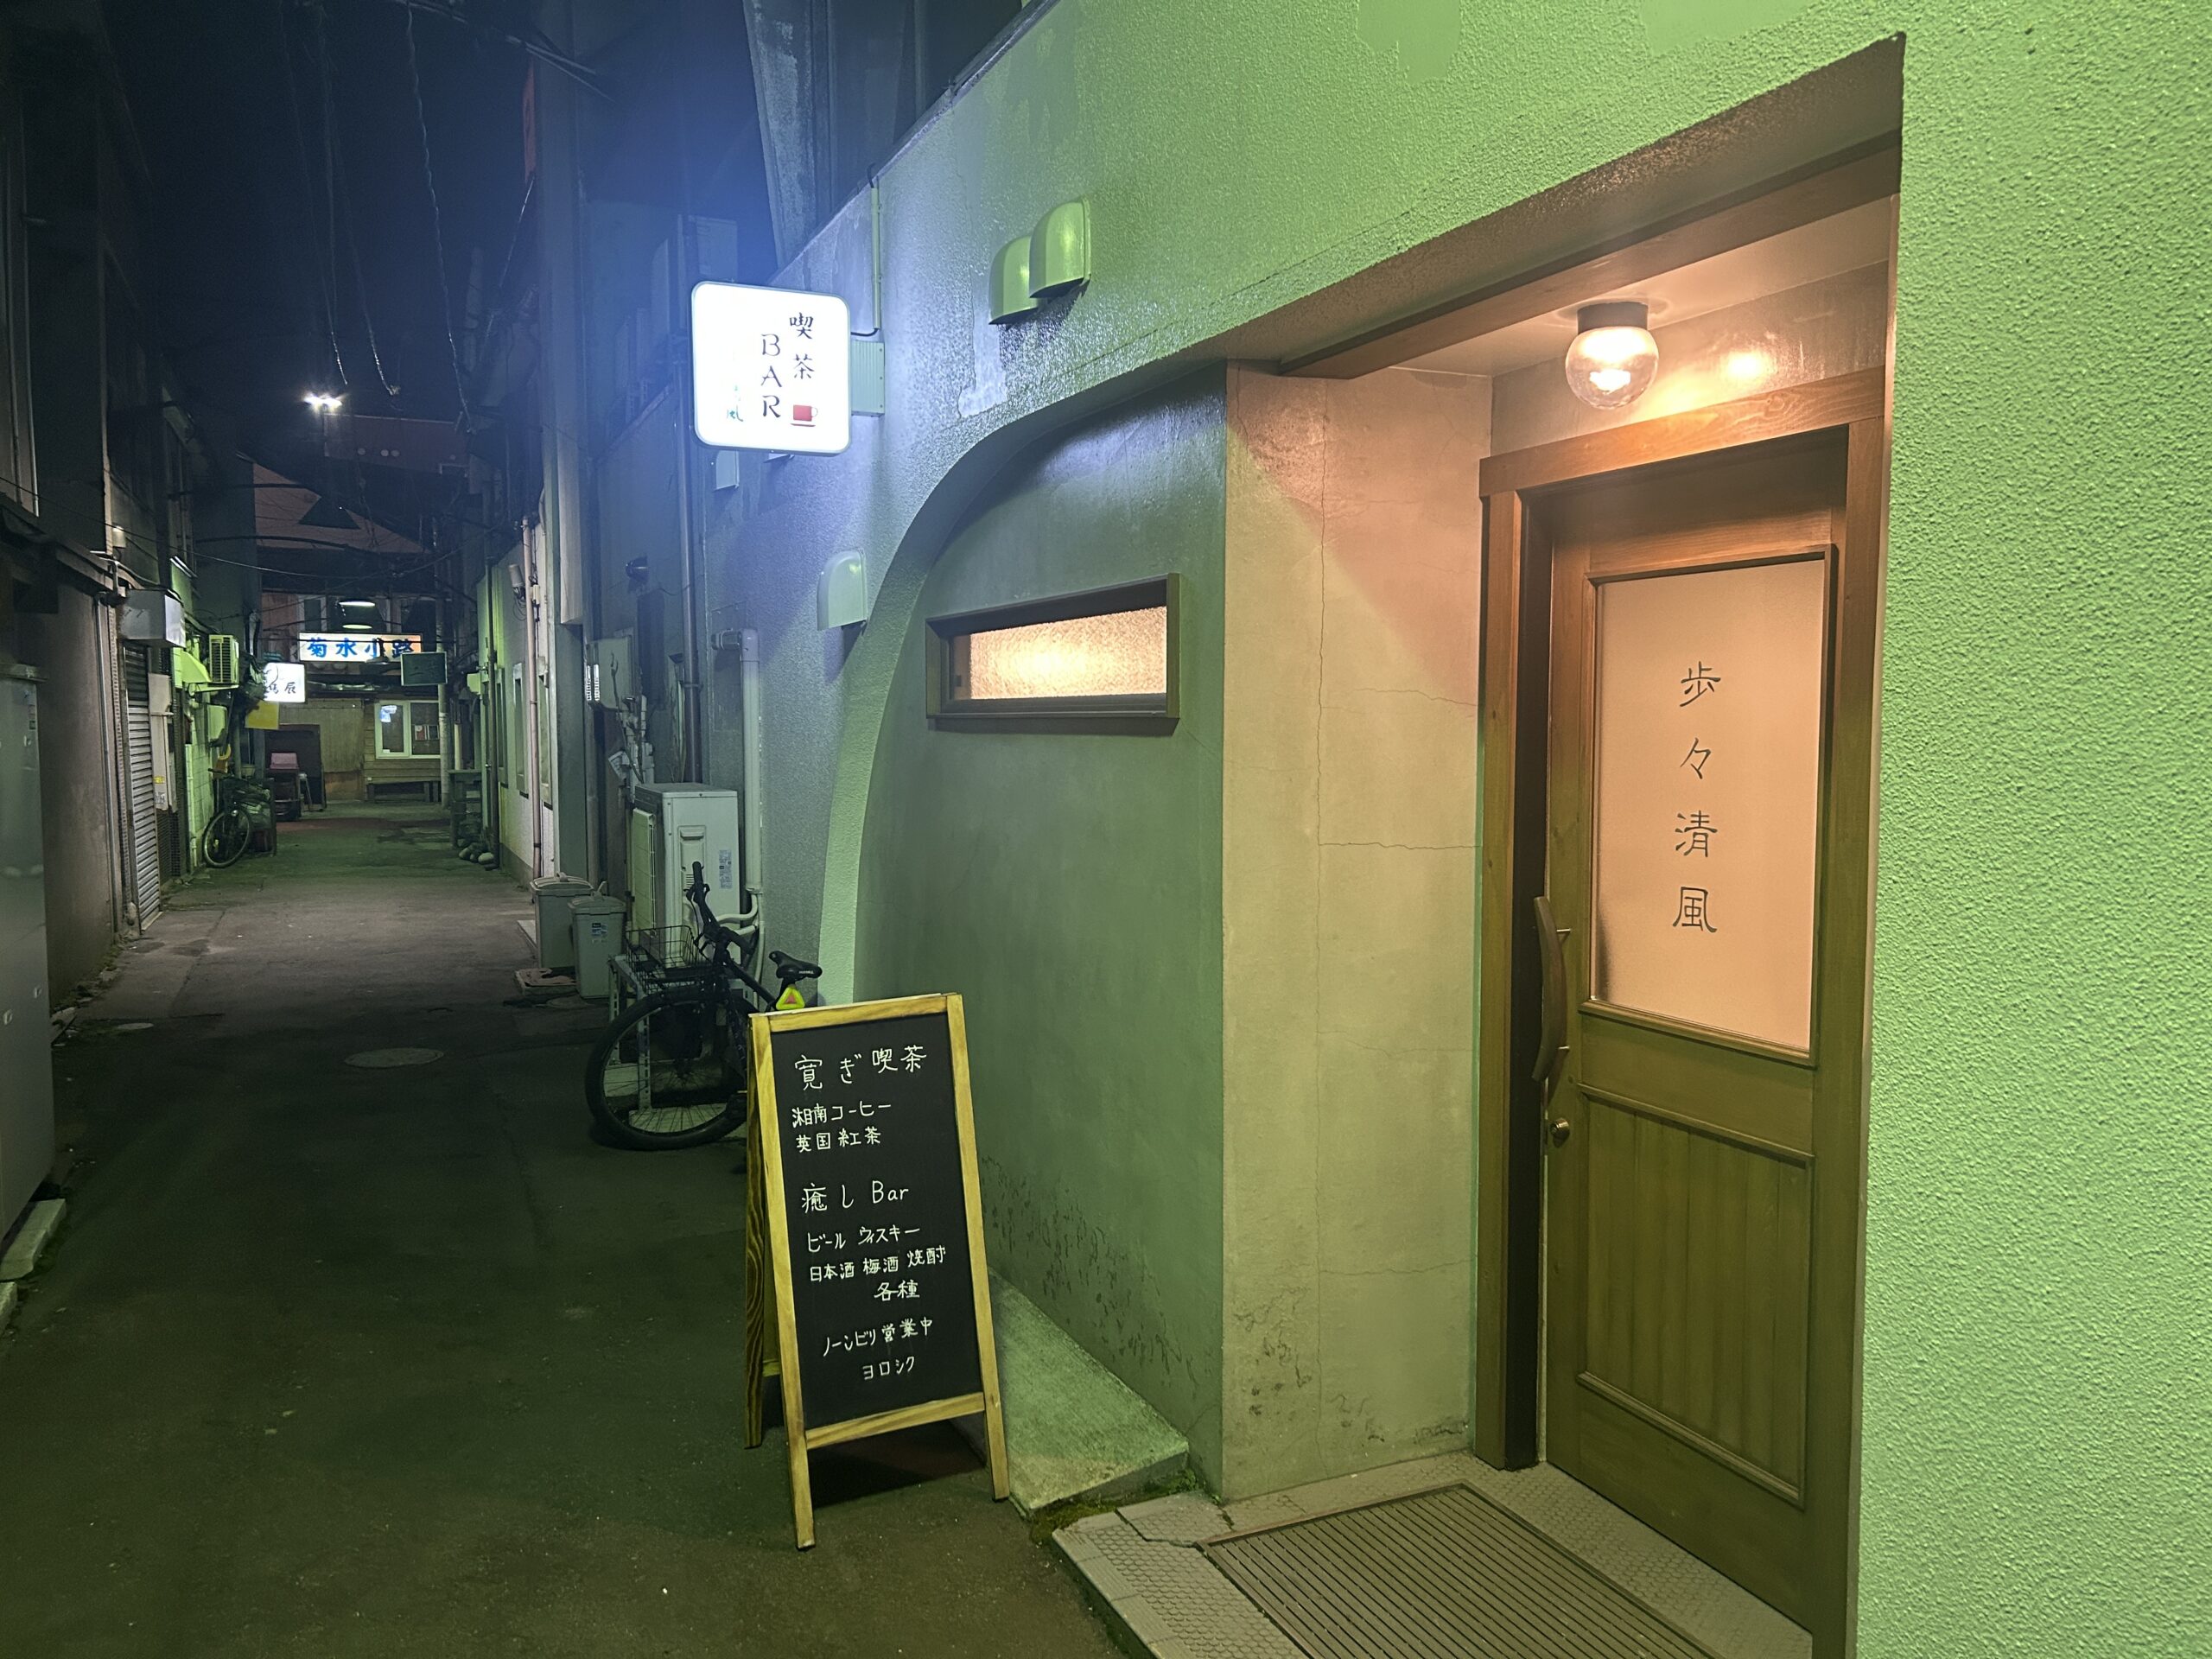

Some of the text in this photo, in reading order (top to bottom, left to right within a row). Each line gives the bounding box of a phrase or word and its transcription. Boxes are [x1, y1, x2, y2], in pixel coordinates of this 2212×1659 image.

[789, 312, 815, 380] 喫茶
[760, 334, 783, 418] BAR
[307, 637, 415, 658] 菊水小路
[1672, 661, 1722, 934] 歩々清風
[791, 1100, 892, 1128] 湘南コーヒー
[795, 1126, 881, 1154] 英国紅茶
[801, 1179, 909, 1214] 癒し Bar
[807, 1224, 920, 1253] ビール ウィスキー
[810, 1244, 946, 1282] 日本酒 梅酒 焼酎
[874, 1279, 920, 1302] 各種
[862, 1356, 915, 1380] ヨロシク
